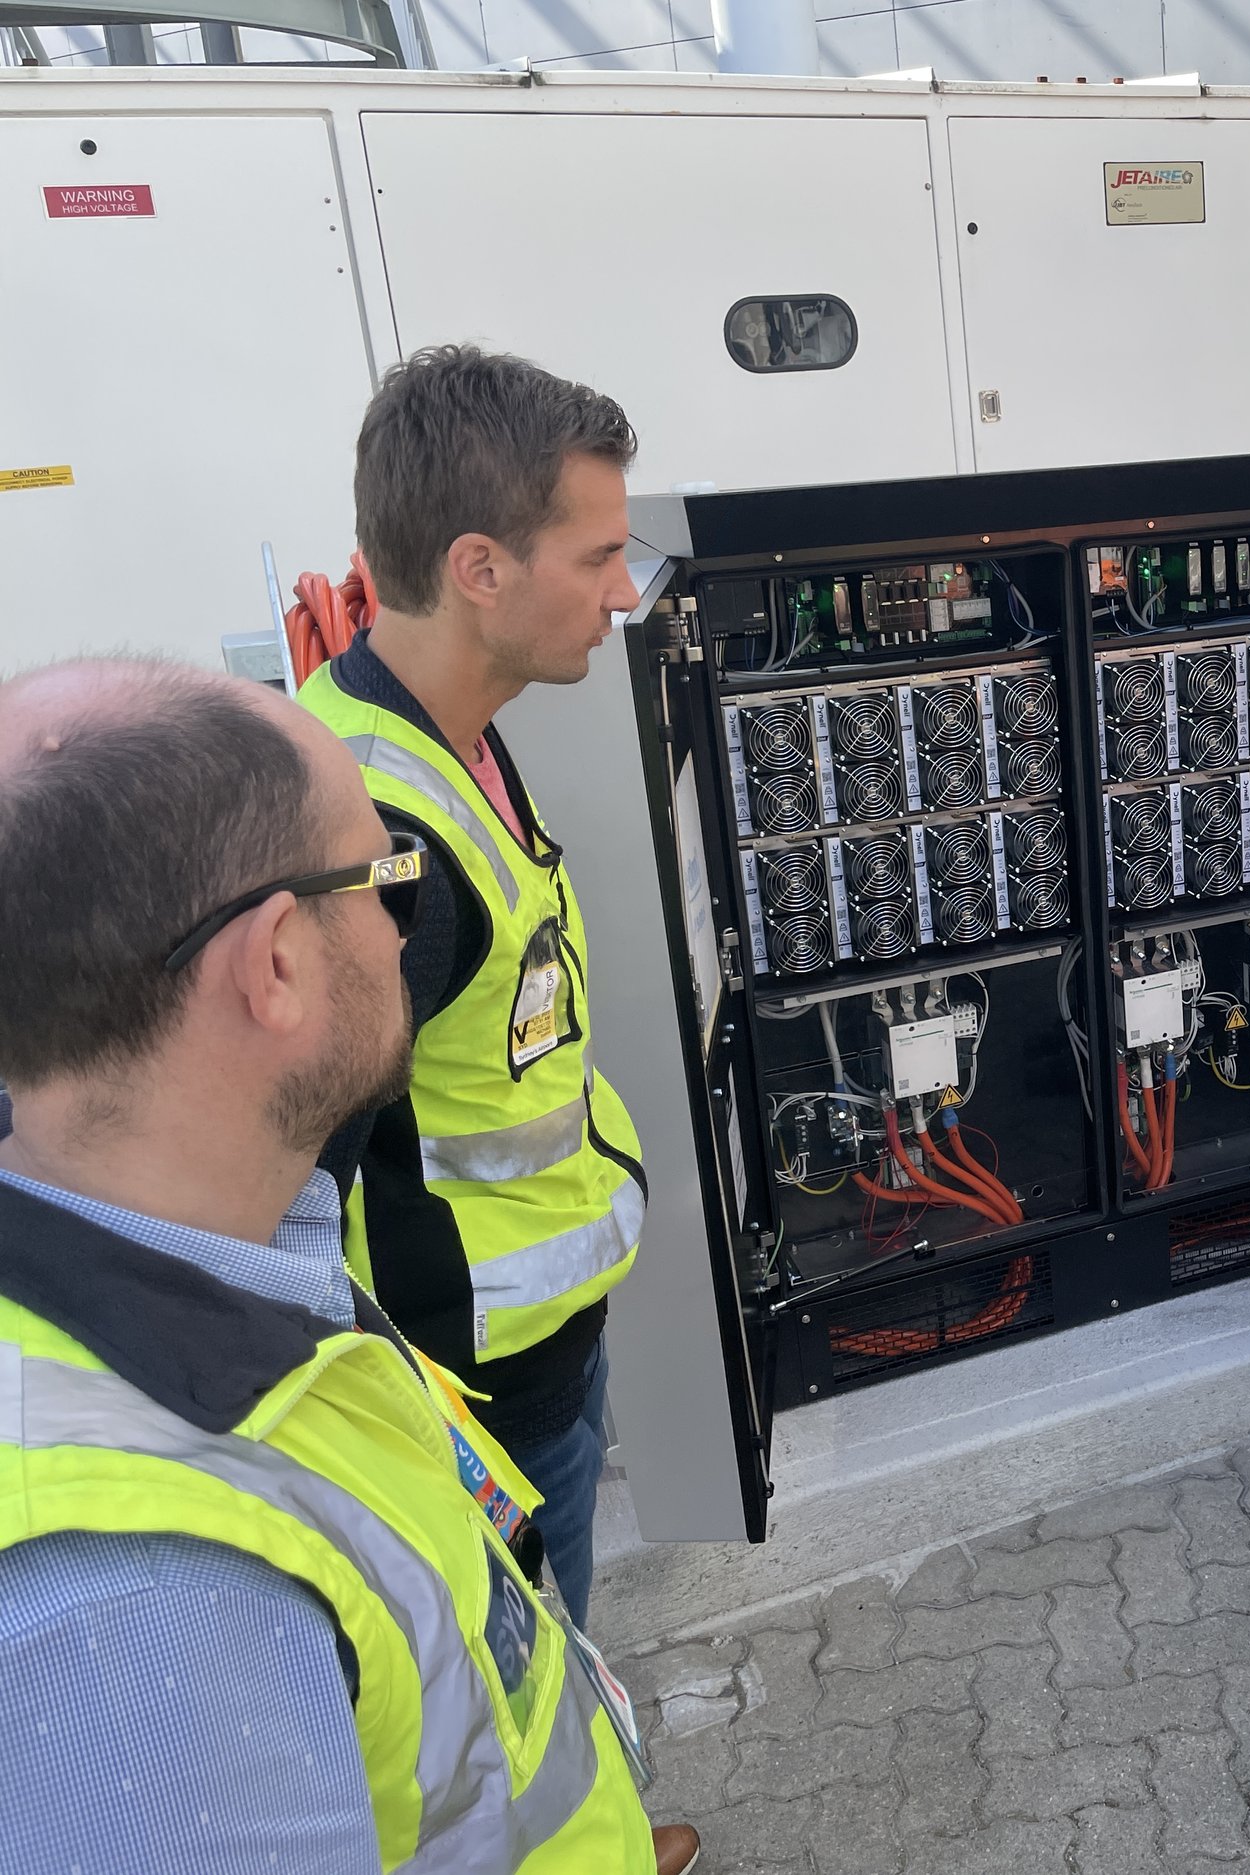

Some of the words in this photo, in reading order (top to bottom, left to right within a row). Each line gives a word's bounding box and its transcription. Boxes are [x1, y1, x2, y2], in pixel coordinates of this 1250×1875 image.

[60, 190, 135, 203] WARNING
[62, 205, 88, 213] HIGH
[90, 203, 138, 213] VOLTAGE
[13, 468, 50, 478] CAUTION
[543, 970, 555, 1012] VISITOR
[514, 1020, 530, 1045] V
[495, 1575, 526, 1674] SYD
